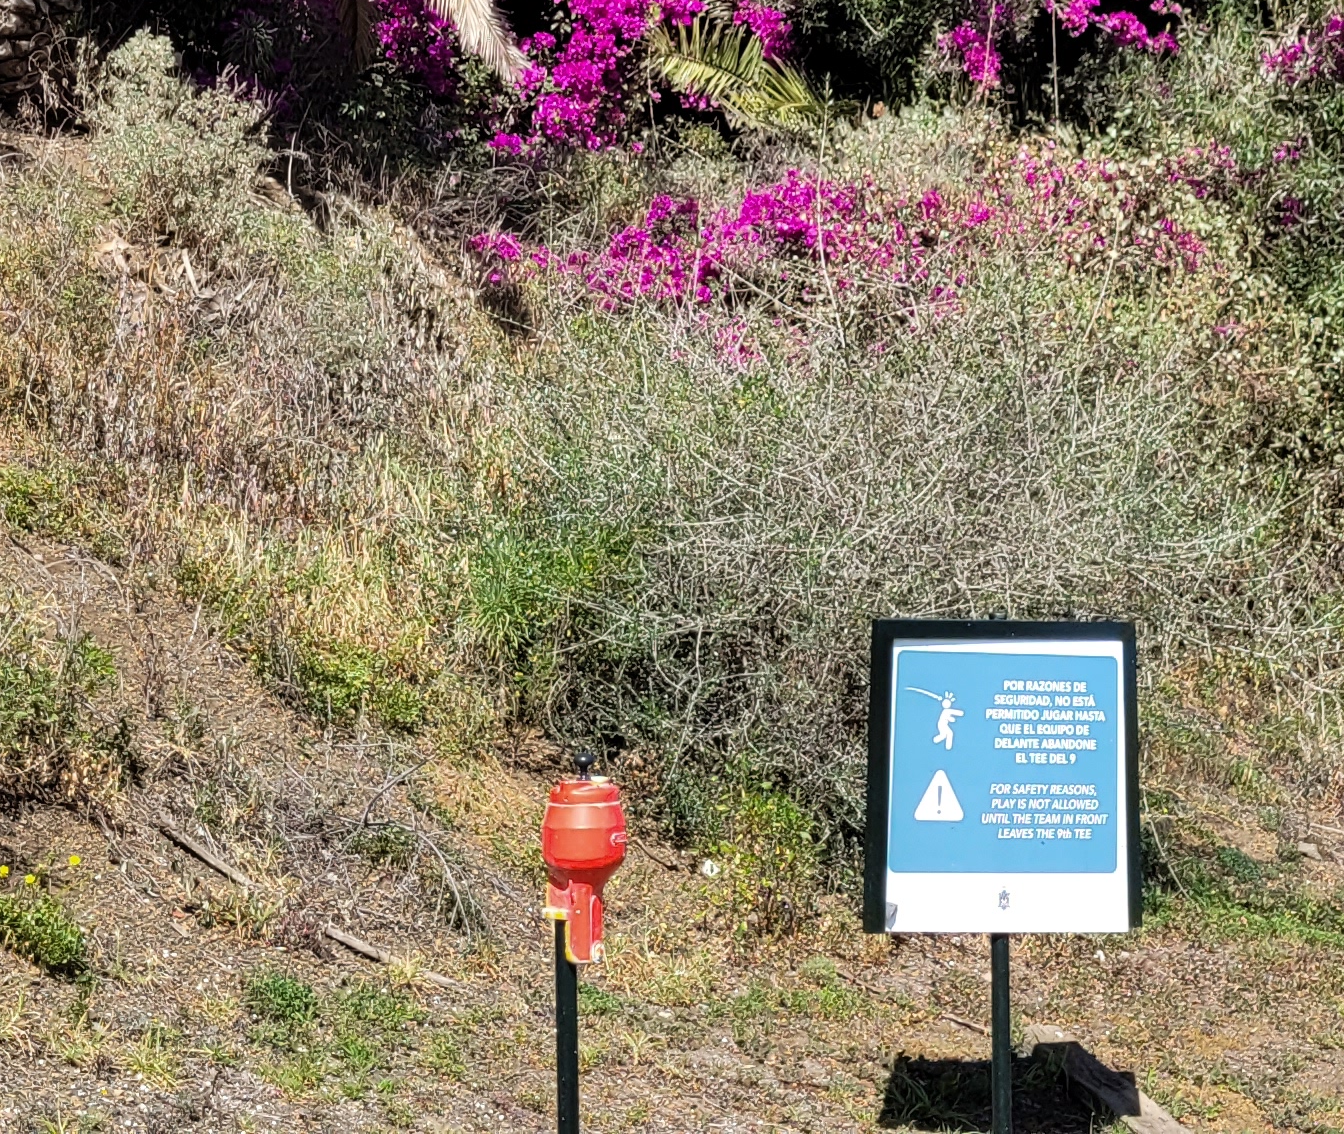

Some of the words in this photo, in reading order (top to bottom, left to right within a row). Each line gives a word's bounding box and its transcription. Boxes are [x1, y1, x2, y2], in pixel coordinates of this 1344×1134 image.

[1003, 680, 1024, 691] POR
[1026, 680, 1071, 692] RAZONES
[1073, 682, 1087, 692] DE
[994, 695, 1052, 707] SEGURIDAD,
[1055, 696, 1071, 706] NO
[1073, 695, 1095, 706] ESTÁ
[986, 709, 1039, 720] PERMITIDO
[1041, 710, 1073, 720] JUGAR
[1075, 711, 1105, 721] HASTA
[1000, 724, 1021, 734] QUE
[1023, 724, 1035, 734] EL
[1037, 725, 1074, 735] EQUIPO
[1076, 725, 1089, 736] DE
[995, 738, 1039, 749] DELANTE
[1041, 739, 1097, 750] ABANDONE
[1016, 753, 1027, 763] EL
[1029, 753, 1048, 764] TEE
[1049, 753, 1068, 764] DEL
[1070, 754, 1076, 764] 9
[990, 784, 1011, 794] FOR
[1012, 784, 1049, 795] SAFETY
[1050, 785, 1096, 796] REASONS,
[992, 799, 1016, 809] PLAY
[1018, 799, 1027, 809] IS
[1028, 799, 1051, 809] NOT
[1052, 799, 1098, 810] ALLOWED
[981, 813, 1010, 824] UNTIL
[1012, 814, 1032, 824] THE
[1034, 814, 1060, 824] TEAM
[1063, 814, 1073, 824] IN
[1076, 814, 1108, 824] FRONT
[998, 829, 1034, 838] LEAVES
[1036, 829, 1055, 839] THE
[1057, 828, 1072, 839] 9th
[1074, 829, 1092, 839] TEE
